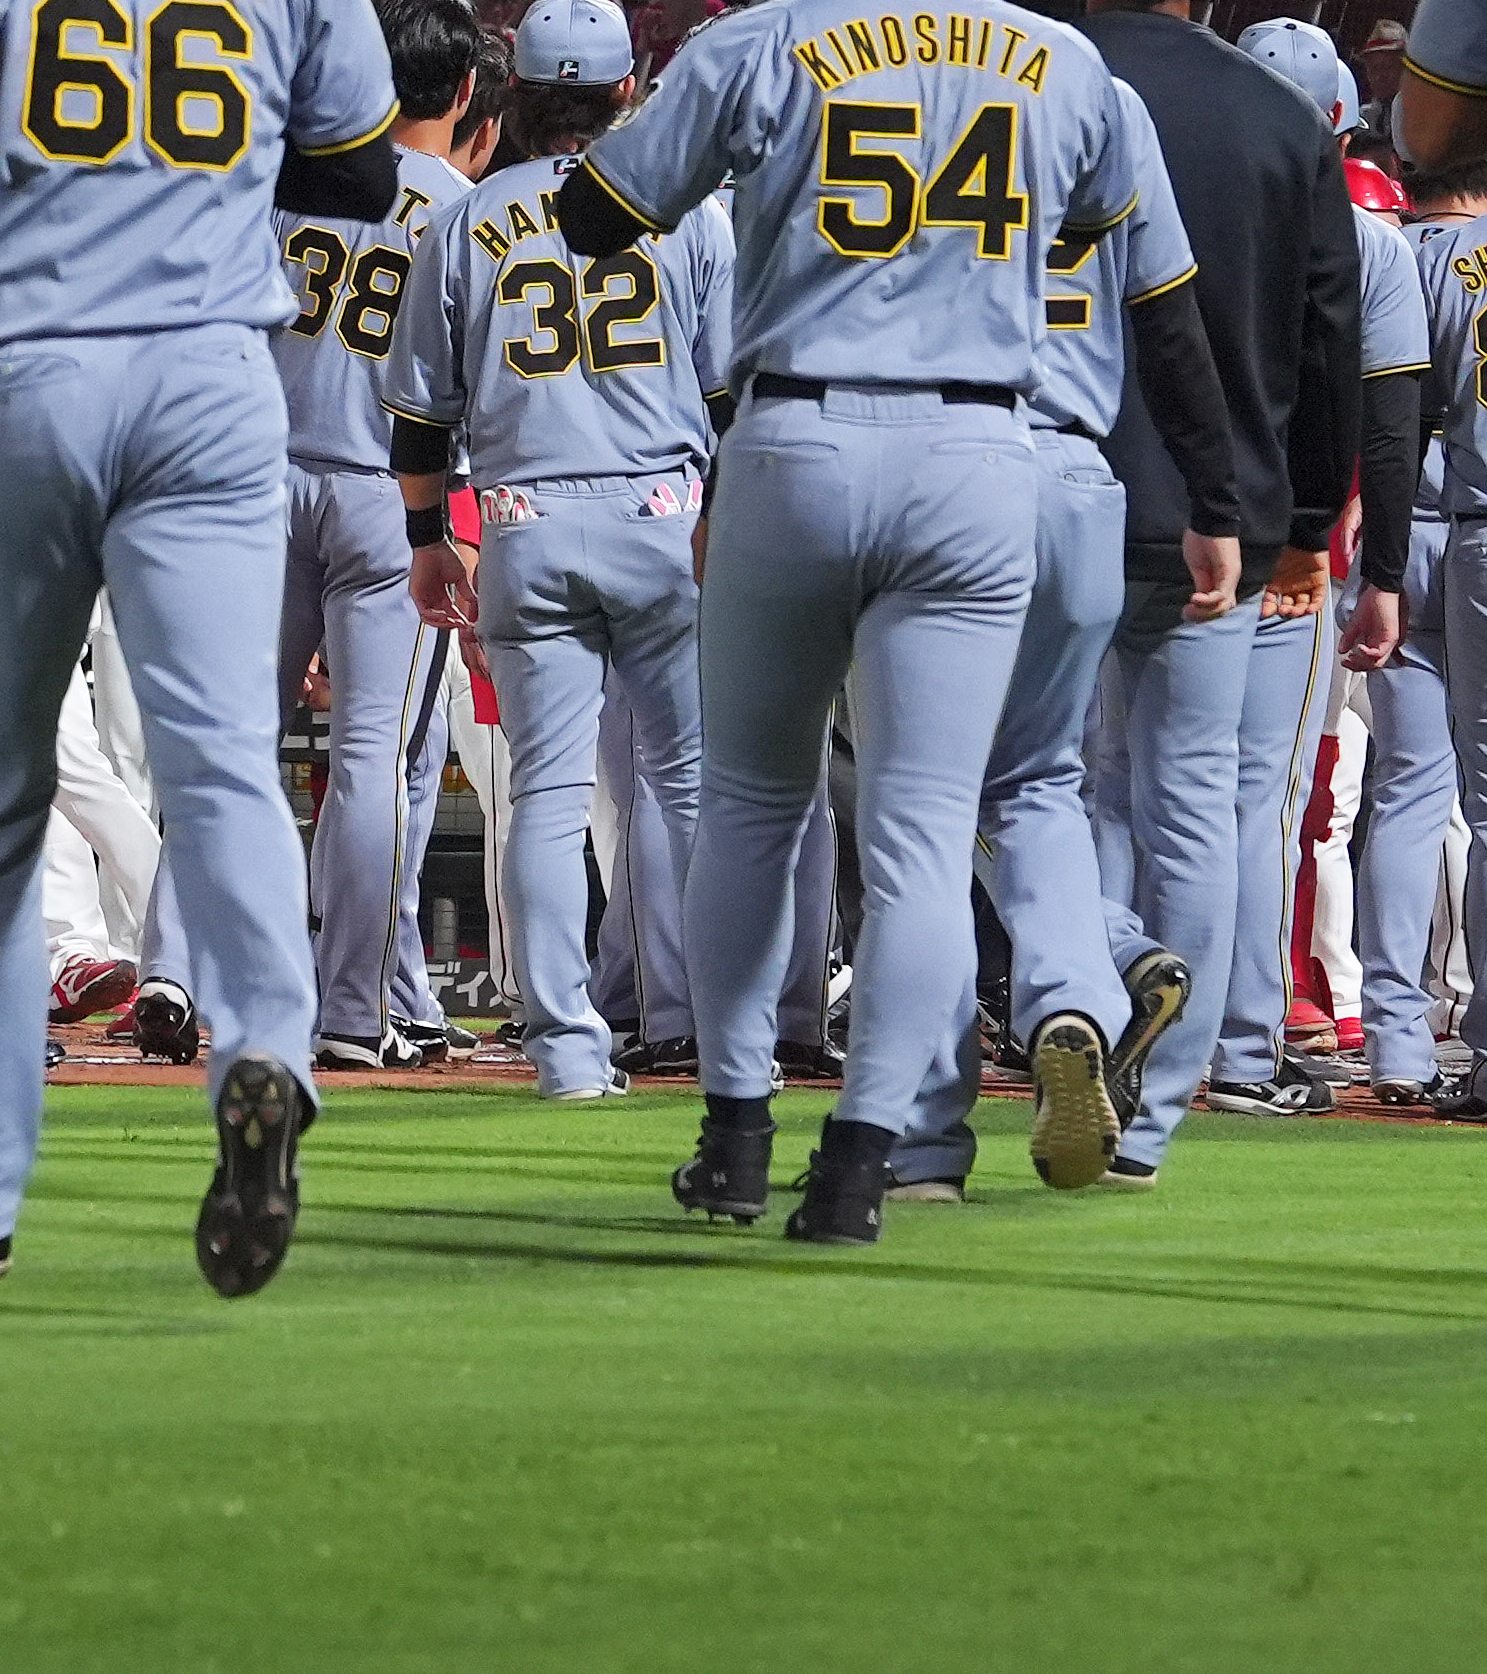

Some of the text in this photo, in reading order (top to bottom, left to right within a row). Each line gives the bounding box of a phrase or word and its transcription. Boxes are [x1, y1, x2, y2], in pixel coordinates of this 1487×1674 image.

[793, 14, 1053, 97] KINOSHITA
[817, 98, 1029, 260] 54
[284, 223, 414, 361] 38
[497, 247, 666, 379] 32
